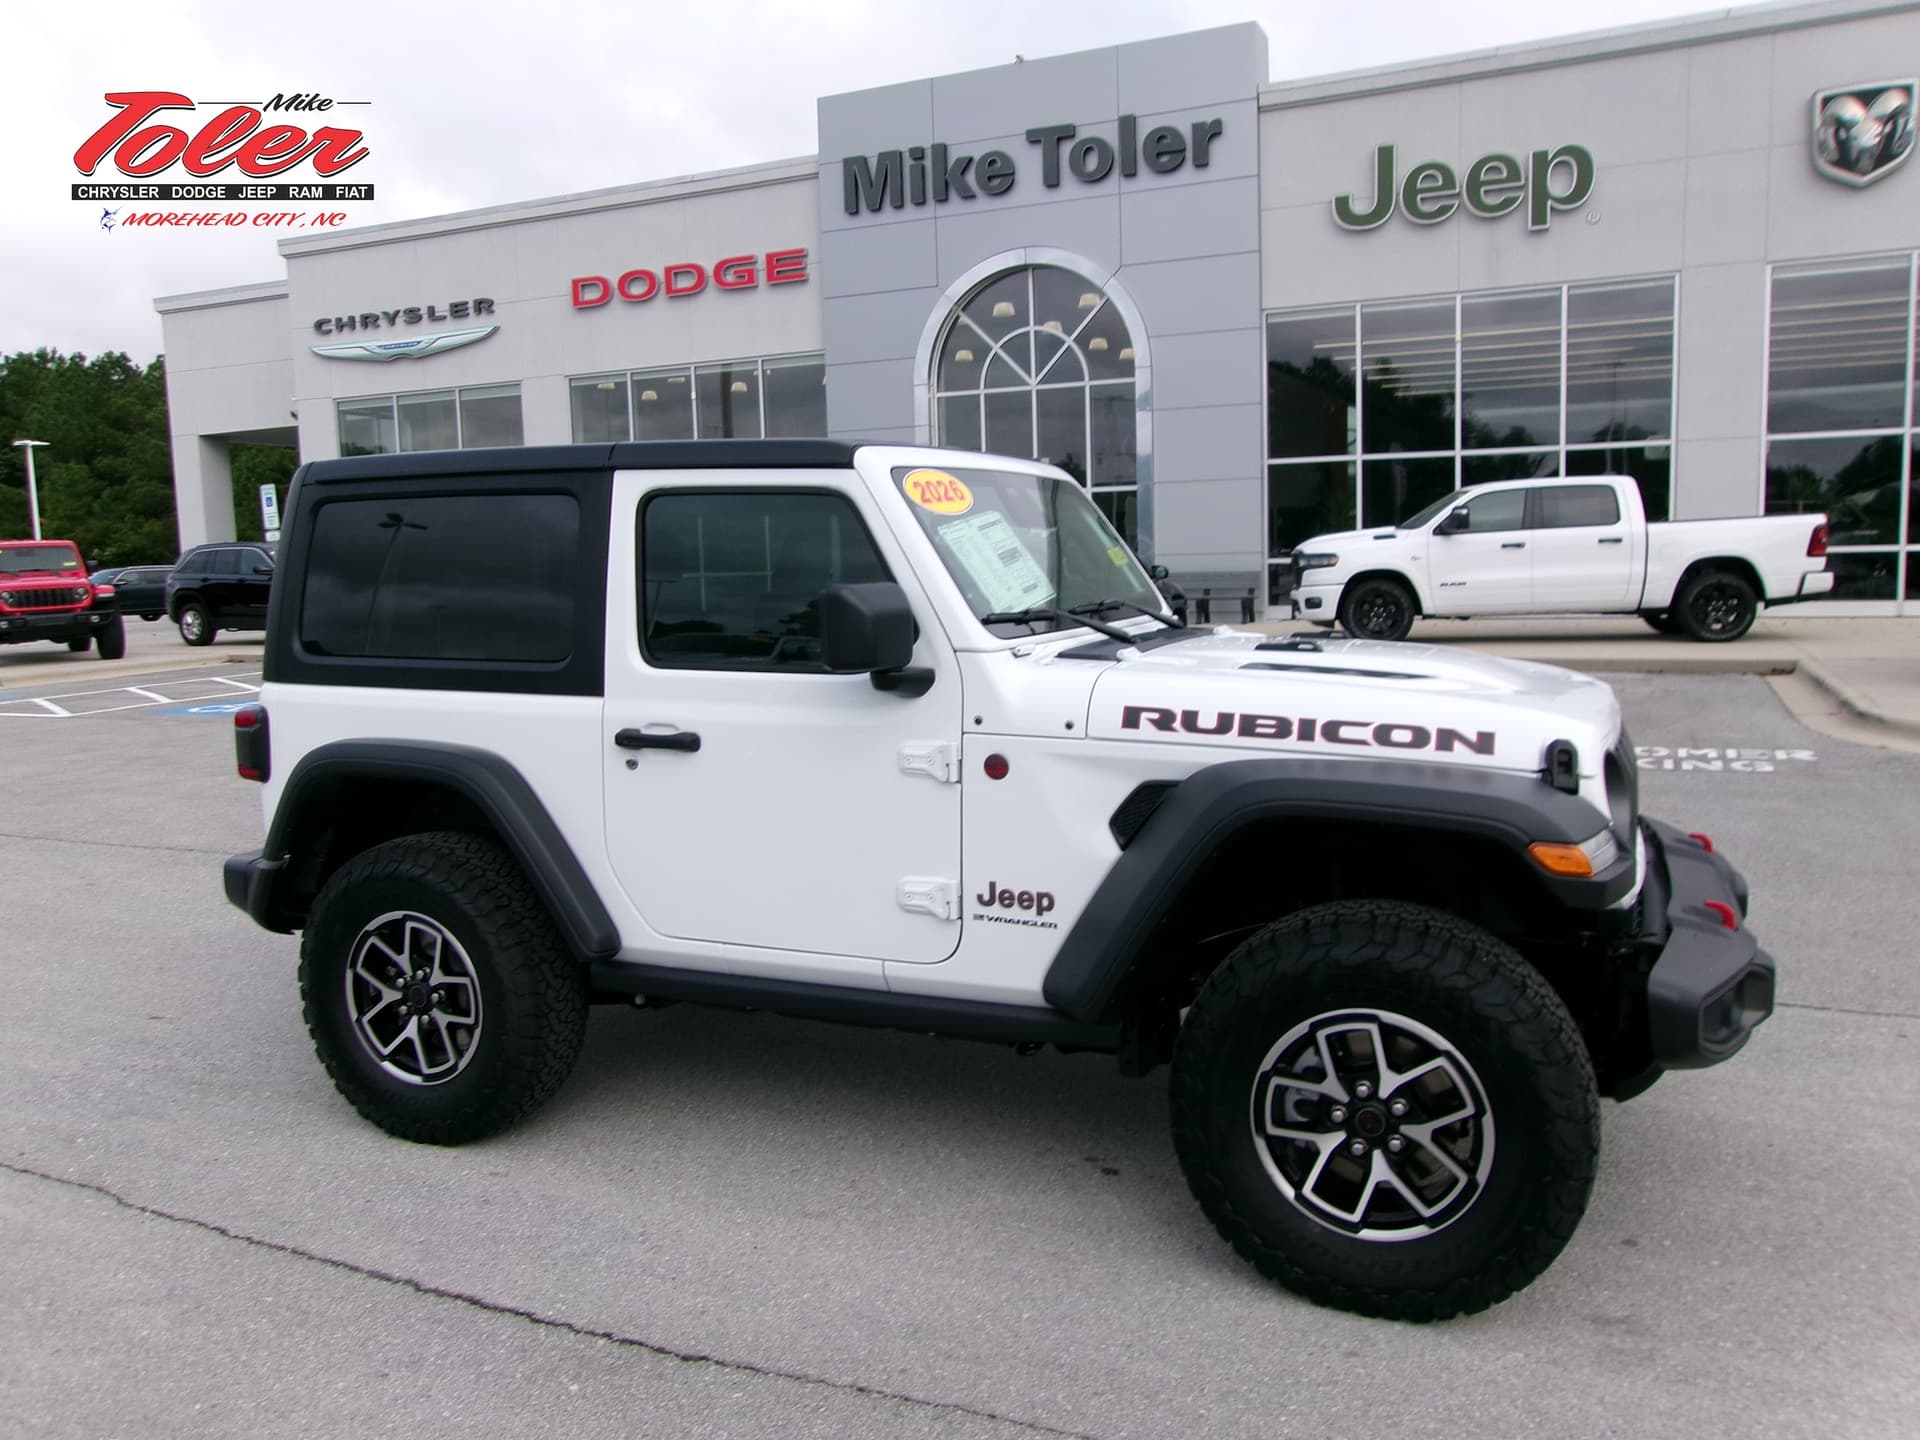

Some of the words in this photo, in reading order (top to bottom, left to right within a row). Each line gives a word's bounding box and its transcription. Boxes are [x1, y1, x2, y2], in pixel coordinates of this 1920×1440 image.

[842, 142, 1016, 215] Mike
[1025, 112, 1223, 188] Toler
[1332, 142, 1597, 232] Jeep
[570, 247, 811, 310] DODGE
[313, 297, 496, 336] CHRYSLER
[912, 480, 965, 503] 2026
[1120, 704, 1497, 756] RUBICON
[976, 880, 1056, 916] Jeep
[986, 914, 1058, 930] WRANGLER
